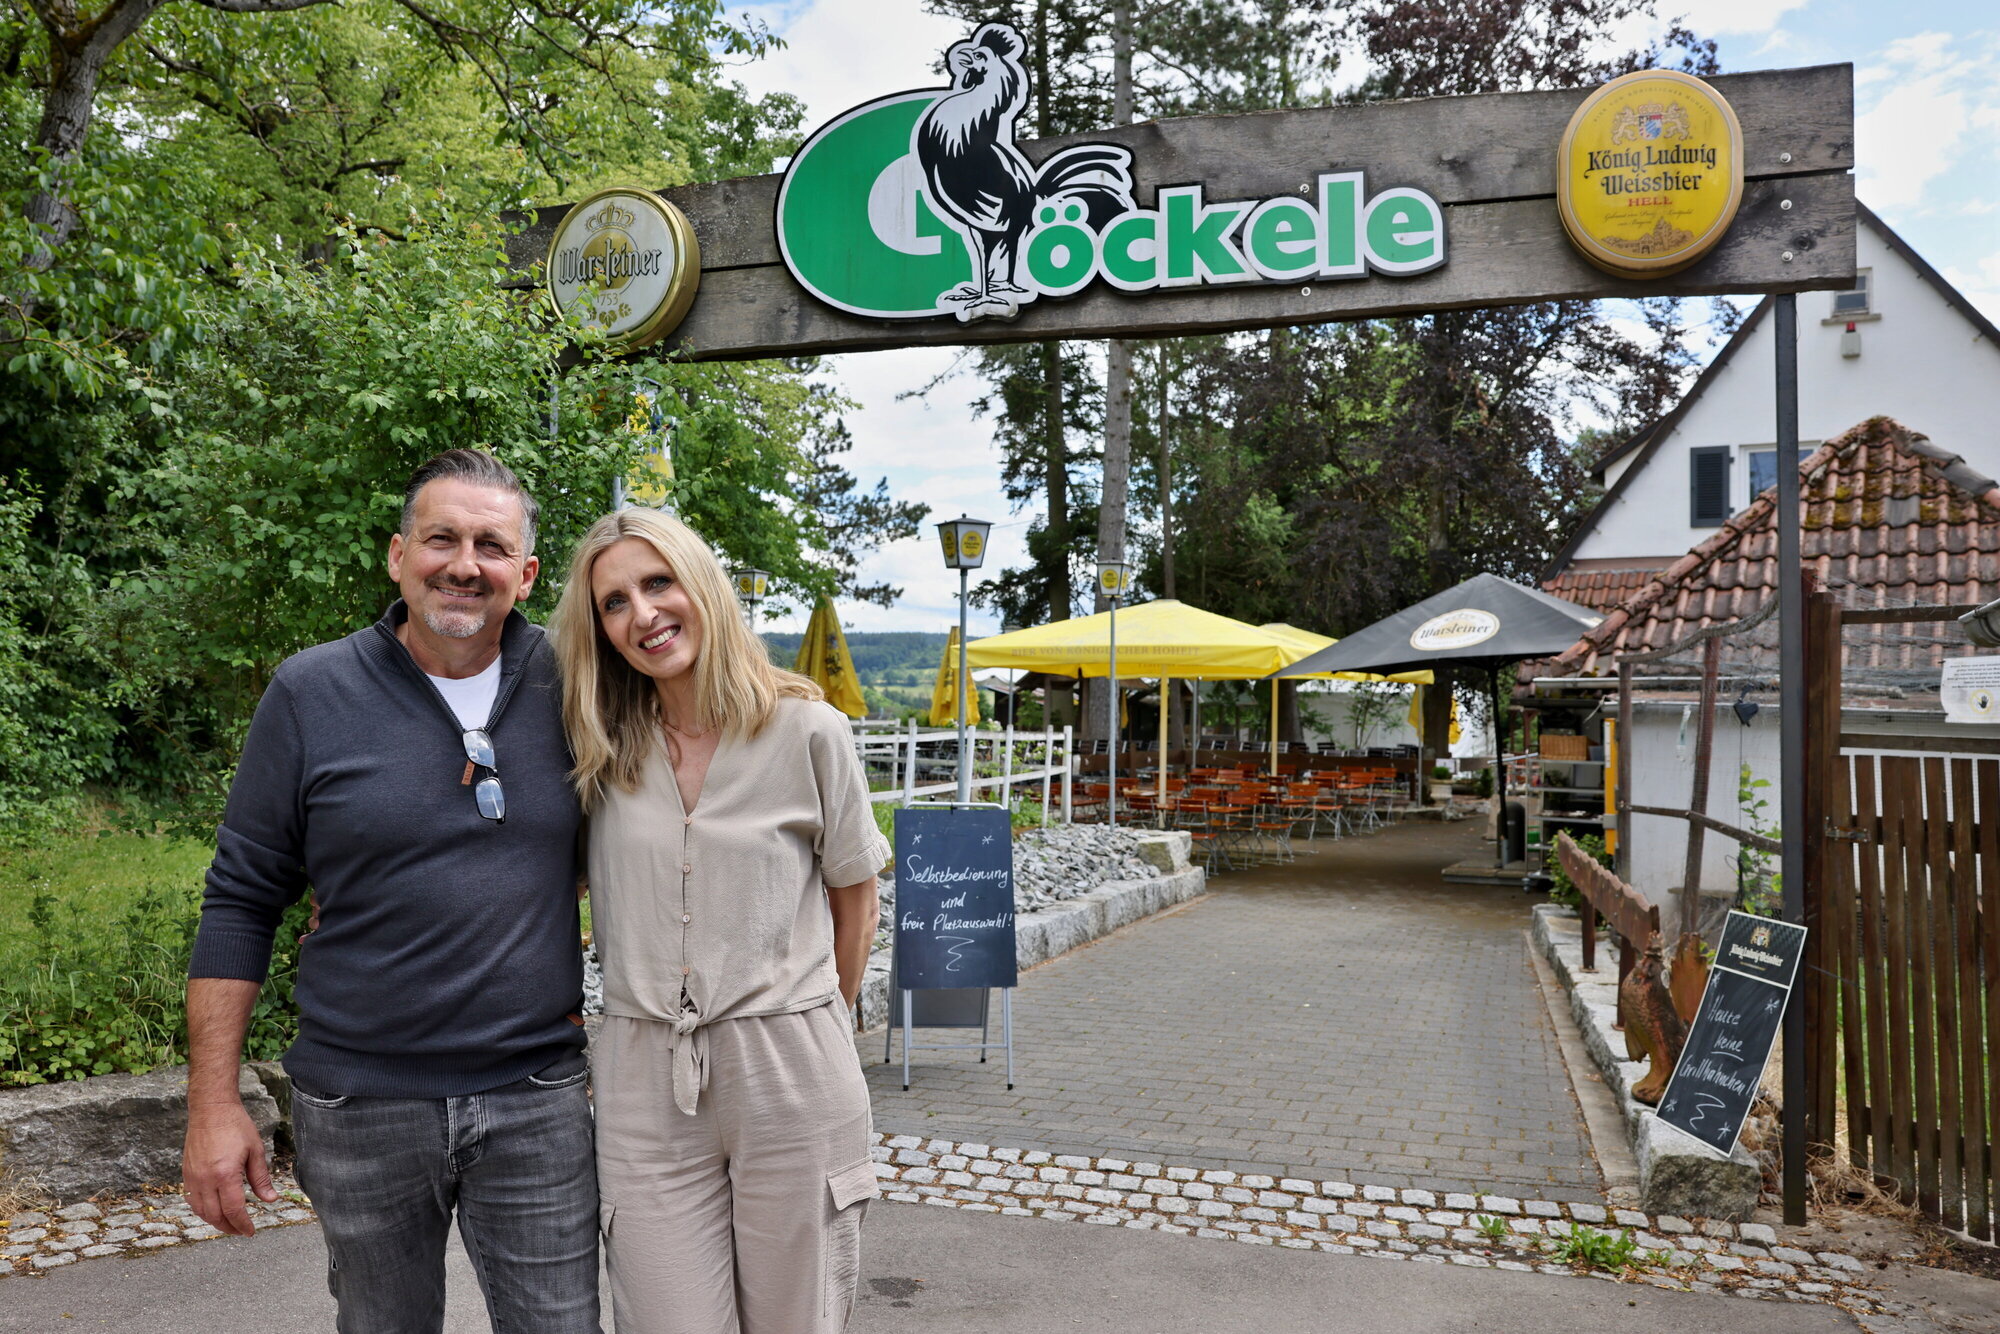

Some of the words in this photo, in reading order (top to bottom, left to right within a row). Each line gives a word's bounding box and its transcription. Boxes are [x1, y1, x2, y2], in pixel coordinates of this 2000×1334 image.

[1584, 148, 1643, 179] König
[1643, 143, 1718, 170] Ludwig
[1601, 171, 1703, 196] Weissbier
[1628, 195, 1673, 207] HELL
[558, 236, 663, 288] Warsteiner
[1420, 622, 1491, 639] Warsteiner
[905, 854, 1008, 889] Selbstbedienung
[941, 891, 966, 909] und
[900, 911, 925, 931] freie
[1707, 995, 1742, 1025] Heute
[1713, 1029, 1744, 1053] keine
